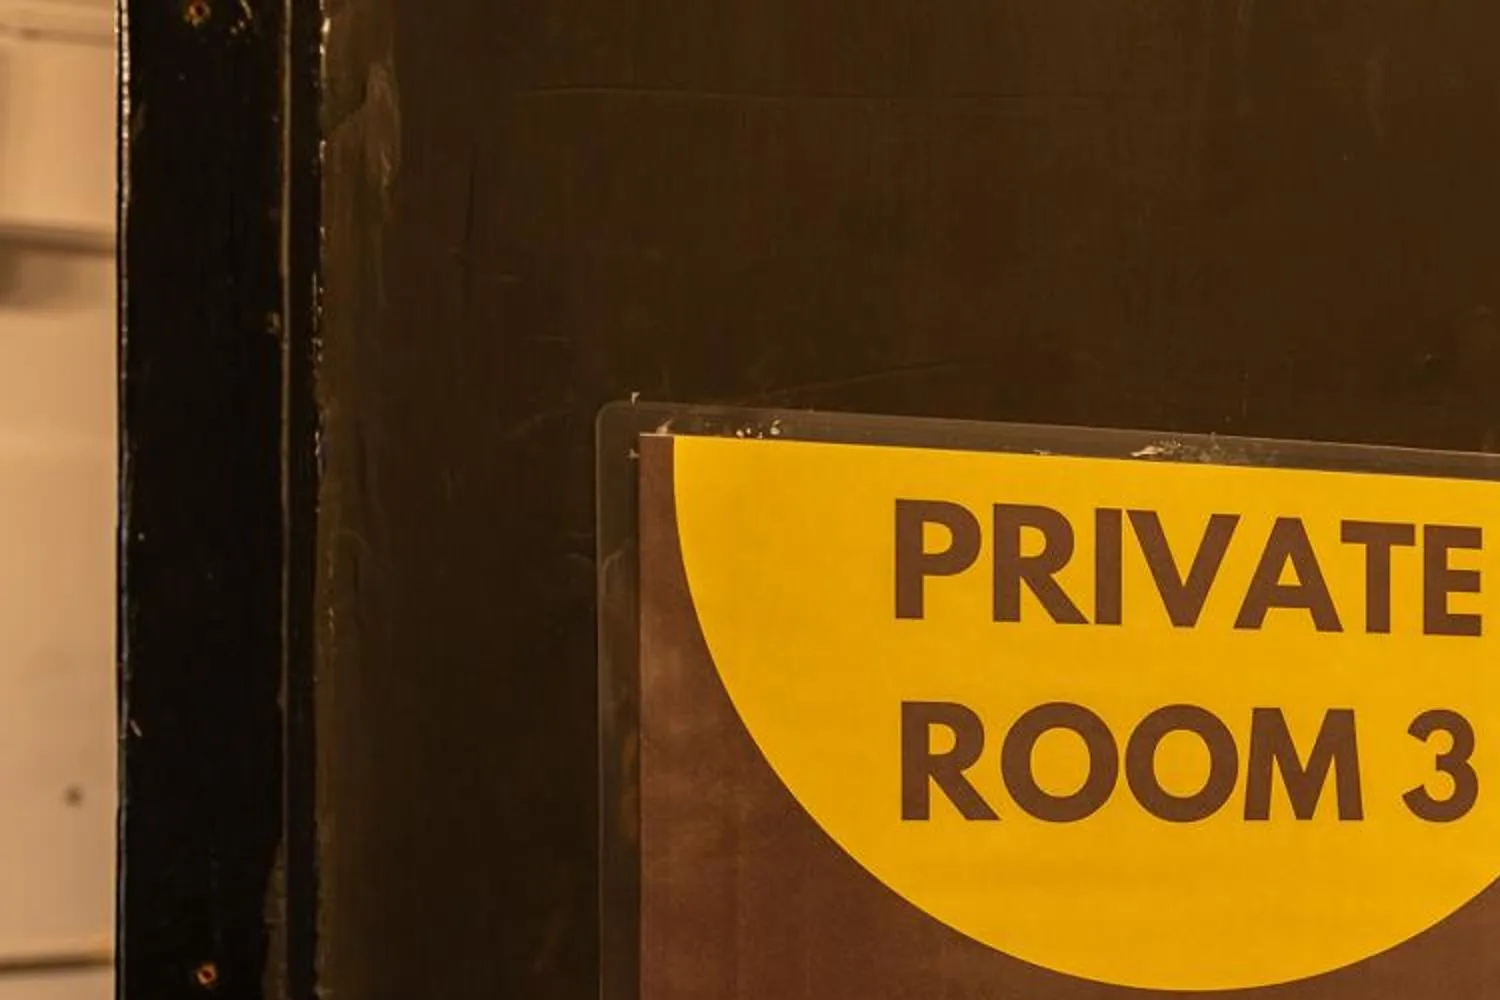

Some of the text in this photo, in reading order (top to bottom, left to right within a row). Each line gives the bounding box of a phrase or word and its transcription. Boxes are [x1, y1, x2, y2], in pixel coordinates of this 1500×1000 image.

[895, 498, 1482, 637] PRIVATE
[901, 701, 1478, 823] ROOM 3
